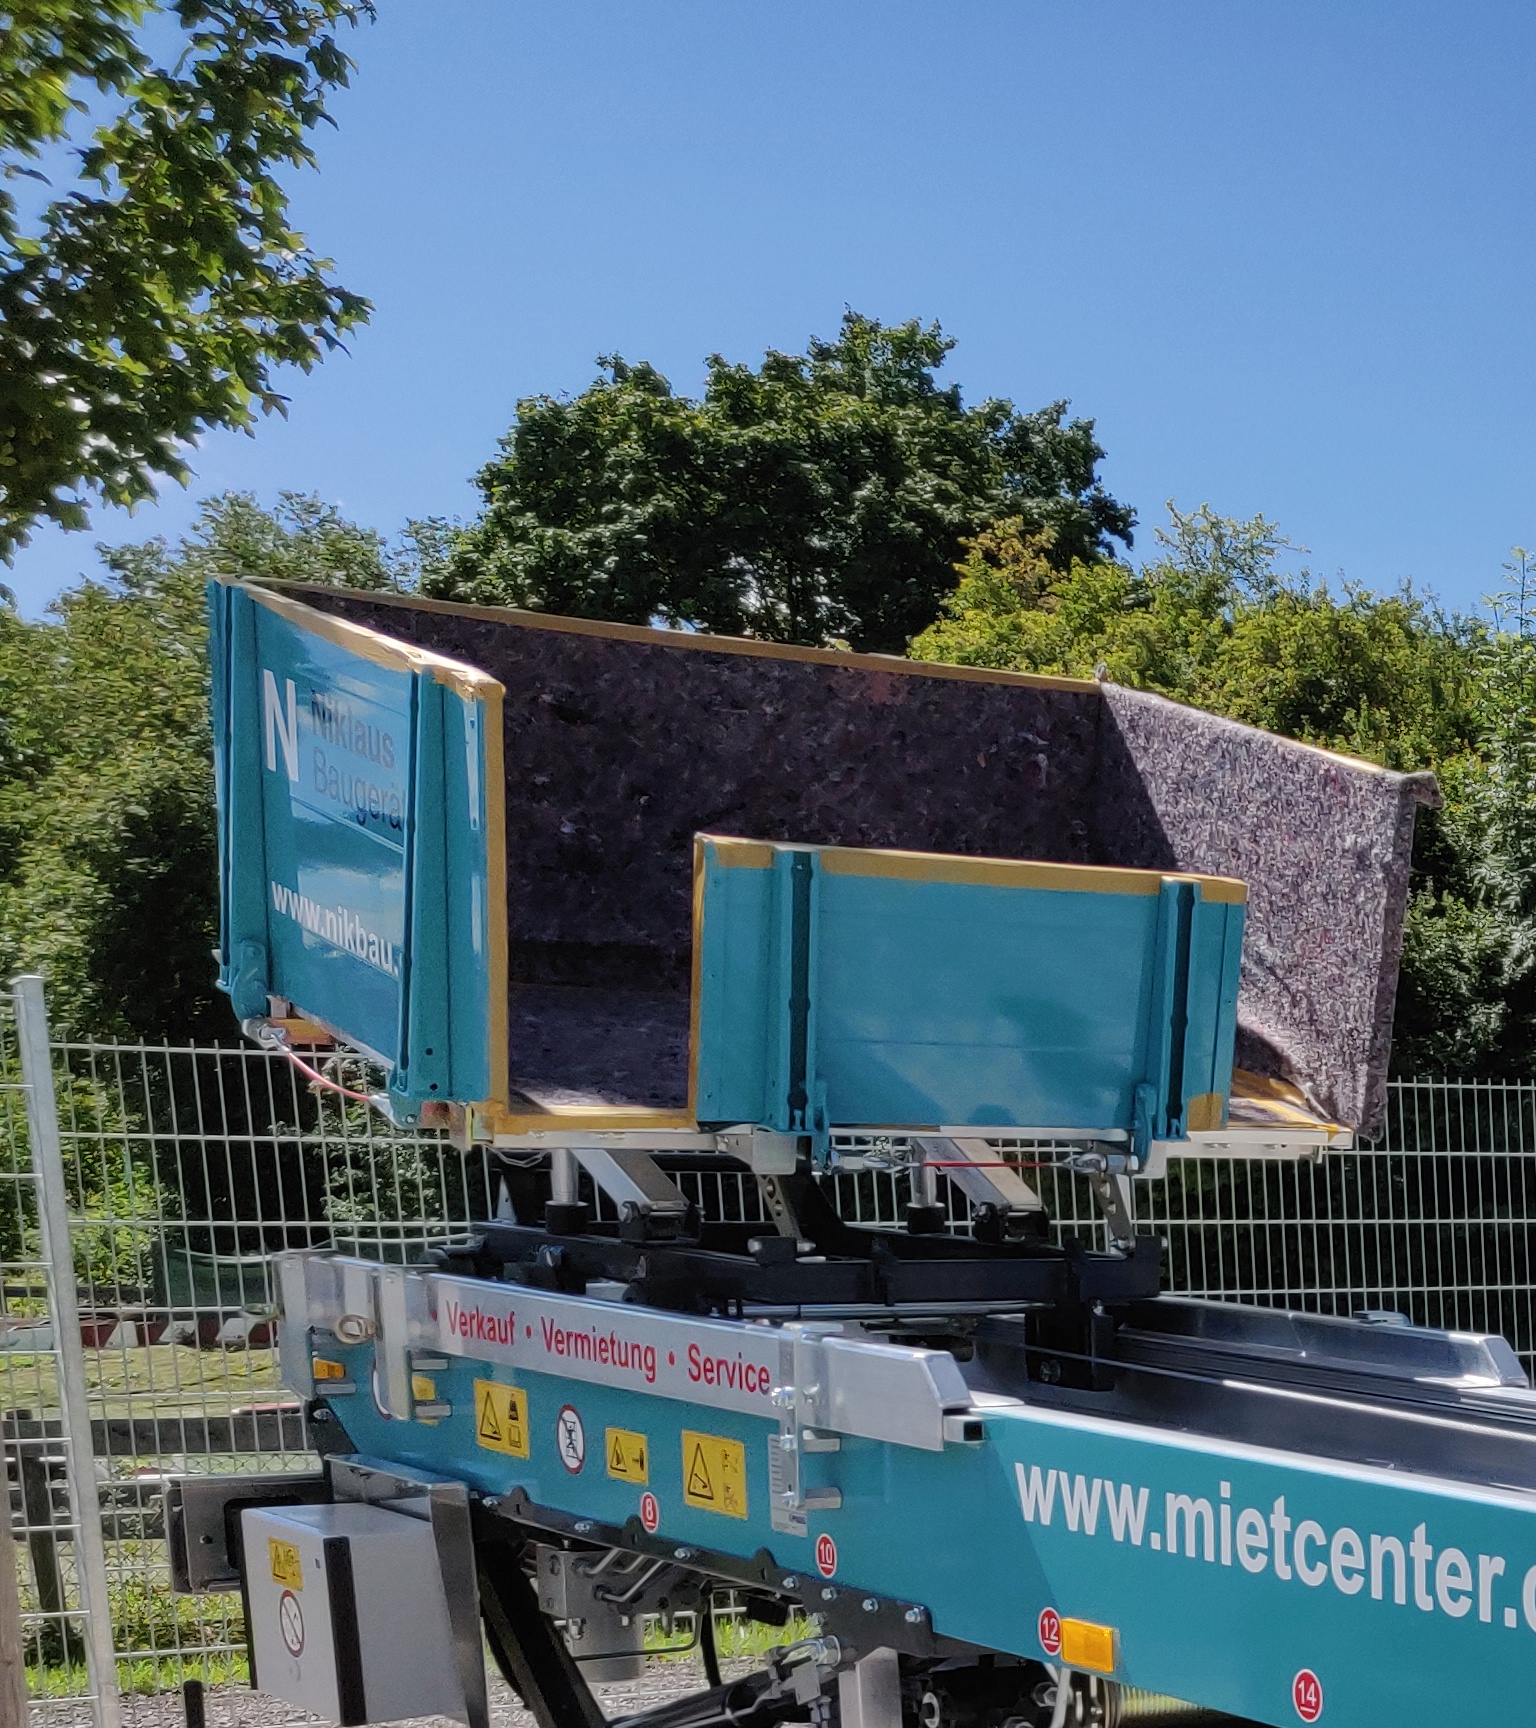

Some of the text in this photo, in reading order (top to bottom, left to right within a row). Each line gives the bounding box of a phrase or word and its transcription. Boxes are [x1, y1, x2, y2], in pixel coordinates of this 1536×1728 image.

[263, 668, 299, 782] N
[310, 688, 396, 770] Niklaus
[446, 1300, 771, 1396] Verkauf Vermietung Service
[820, 1542, 834, 1564] 10
[1042, 1617, 1059, 1641] 12
[1298, 1680, 1317, 1707] 14
